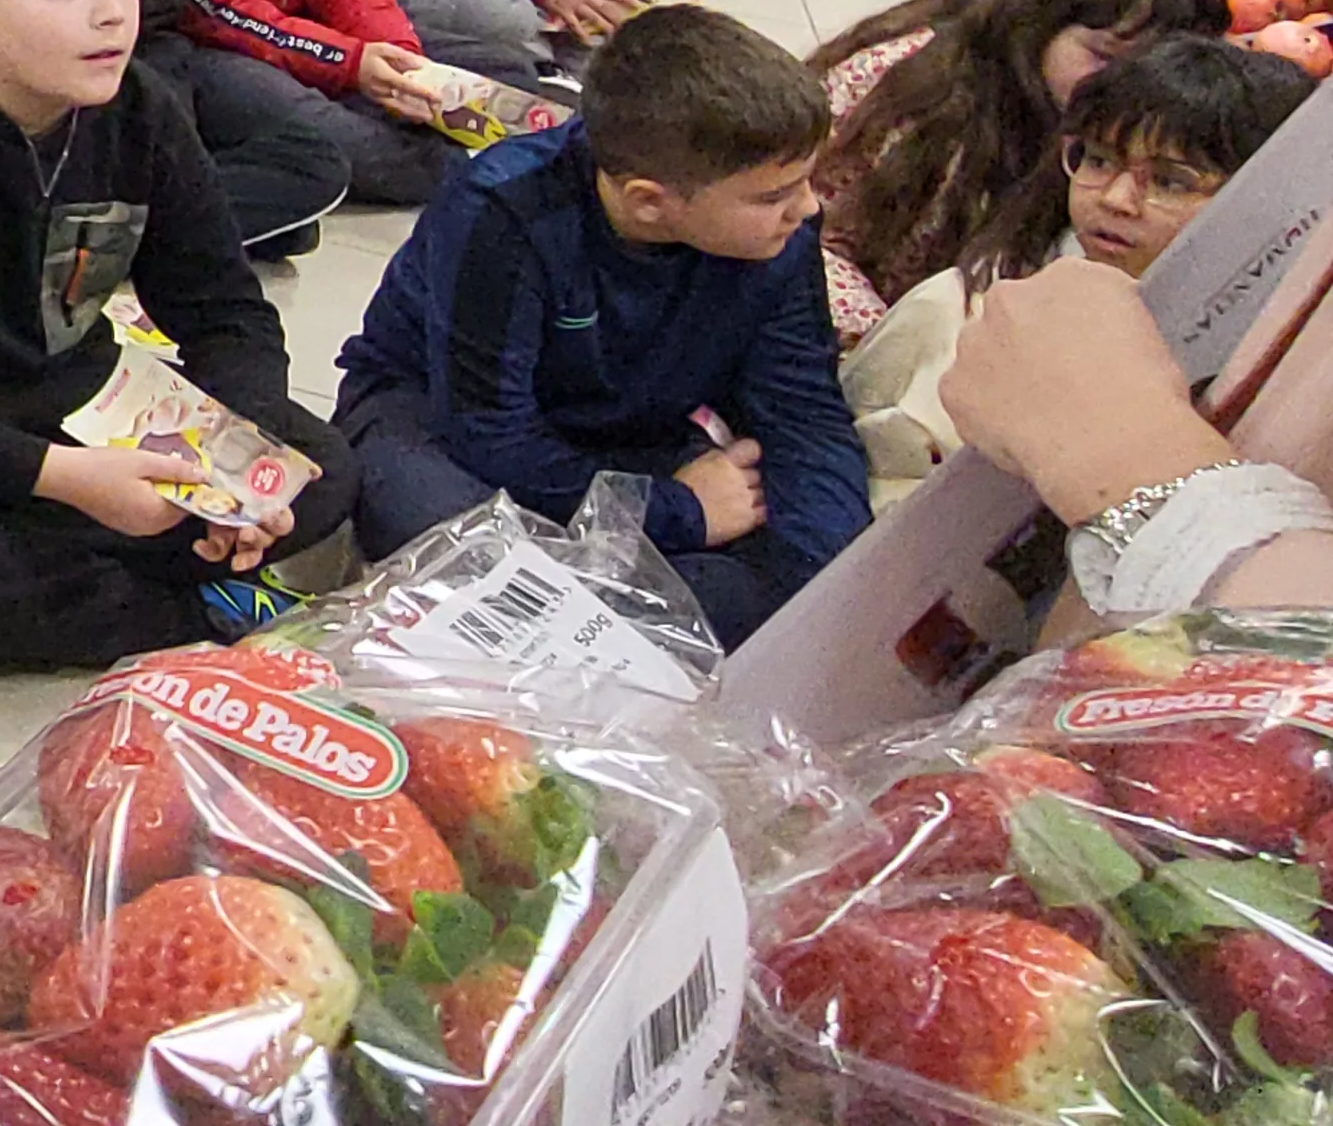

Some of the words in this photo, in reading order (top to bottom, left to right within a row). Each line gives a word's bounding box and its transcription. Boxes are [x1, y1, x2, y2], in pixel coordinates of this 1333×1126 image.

[573, 612, 613, 647] 500g
[188, 681, 250, 731] de
[242, 700, 378, 784] Palos
